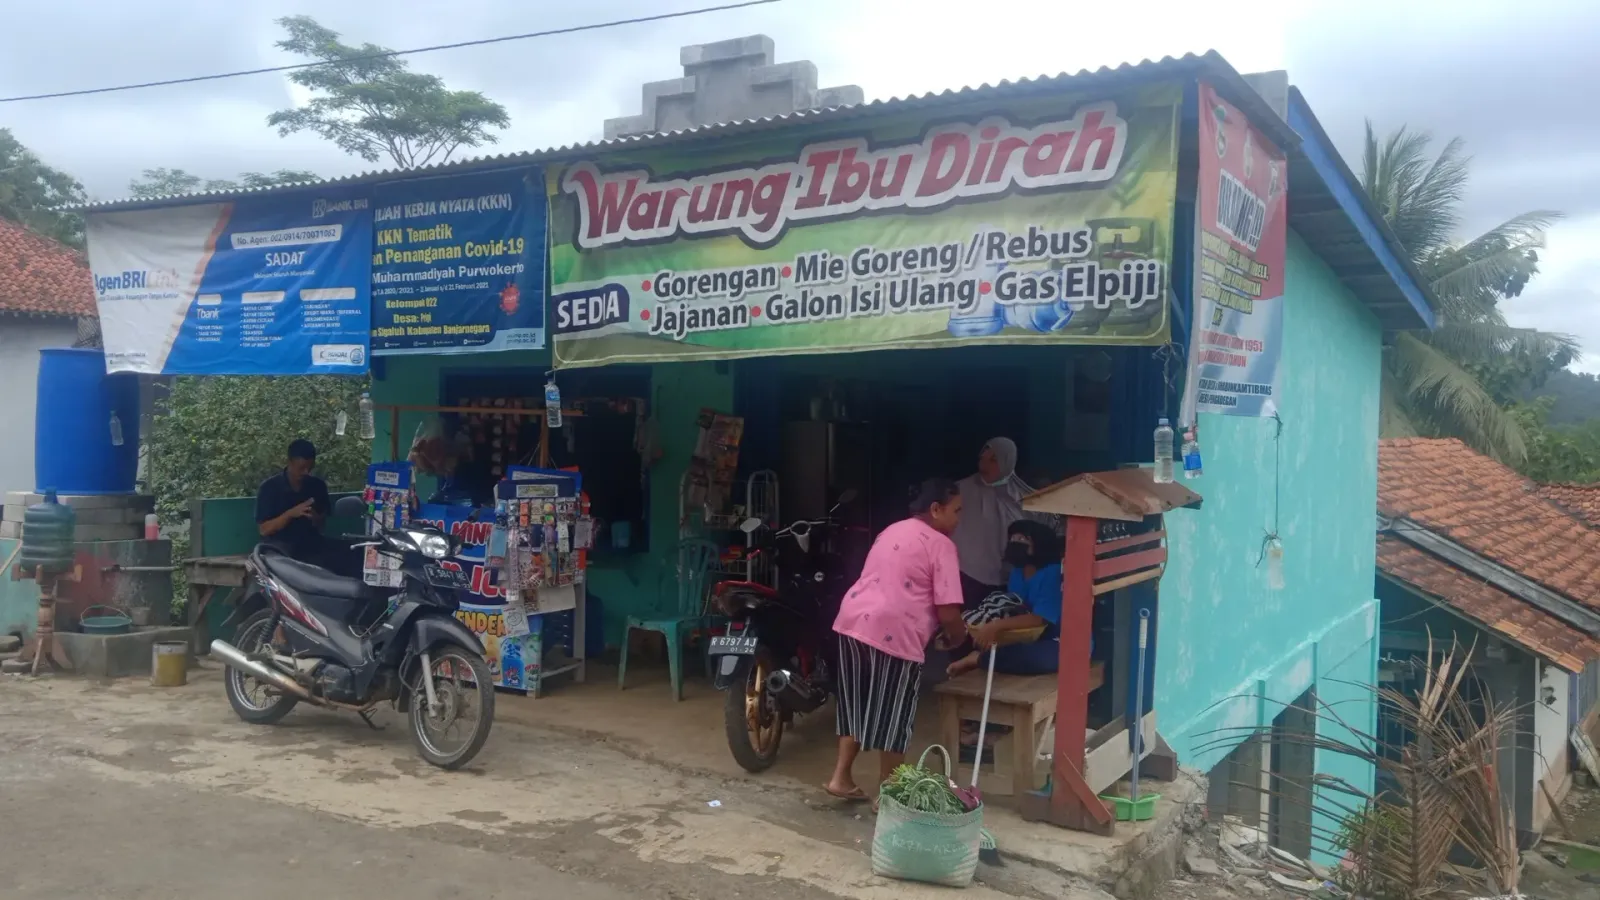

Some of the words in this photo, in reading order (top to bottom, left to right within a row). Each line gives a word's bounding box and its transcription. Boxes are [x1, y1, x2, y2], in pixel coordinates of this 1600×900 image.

[568, 170, 791, 238] Warung
[794, 148, 912, 211] Ibu
[915, 110, 1116, 197] Dirah
[404, 201, 437, 218] KERJA
[439, 198, 475, 214] NYATA
[477, 193, 512, 213] (KKN)
[377, 229, 402, 246] KKN
[407, 224, 453, 243] Tematik
[265, 251, 305, 267] SADAT
[385, 246, 462, 264] Penanganan
[465, 238, 524, 258] Covid-19
[653, 265, 776, 298] Gorengan
[794, 253, 844, 283] Mie
[852, 243, 958, 276] Goreng
[986, 227, 1088, 260] Rebus
[372, 268, 455, 284] Muhammadiyah
[459, 263, 524, 277] Purwokerto
[652, 304, 748, 337] Jajanan
[765, 291, 841, 320] Galon
[851, 283, 880, 311] Isi
[889, 278, 976, 309] Ulang
[995, 271, 1055, 301] Gas
[1066, 262, 1156, 306] Elpiji
[711, 638, 718, 646] R
[720, 637, 742, 646] 6797
[744, 638, 757, 646] AJ
